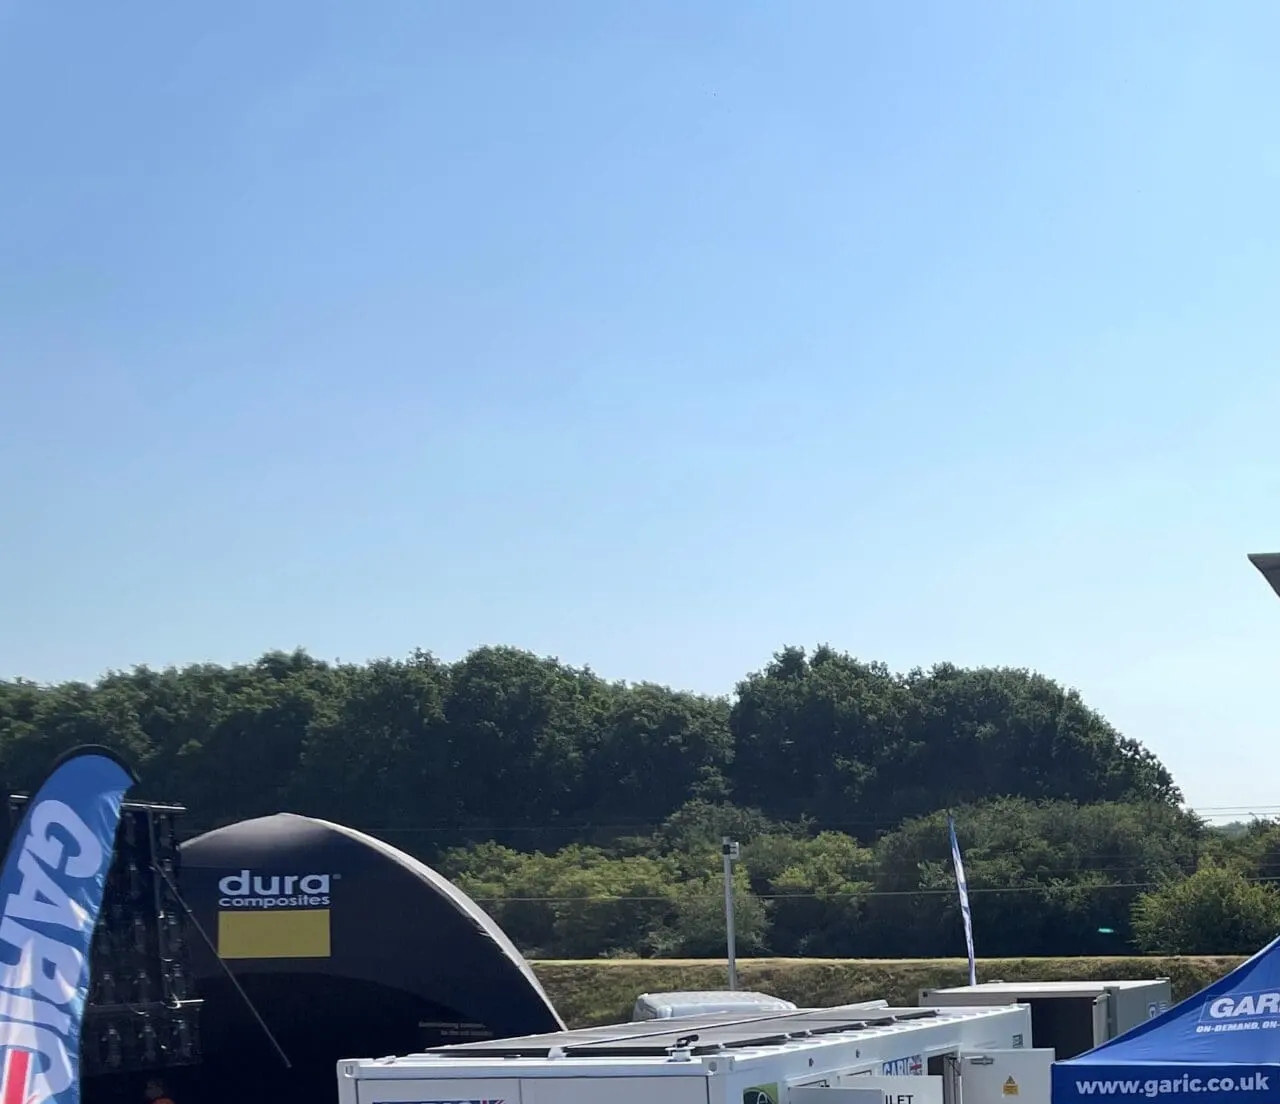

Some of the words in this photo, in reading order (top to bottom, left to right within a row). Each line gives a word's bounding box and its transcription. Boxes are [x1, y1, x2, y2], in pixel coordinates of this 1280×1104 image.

[218, 870, 330, 895] dura
[218, 895, 331, 908] composites
[0, 799, 102, 1097] GARIC
[1076, 1072, 1269, 1098] www.garic.co.uk
